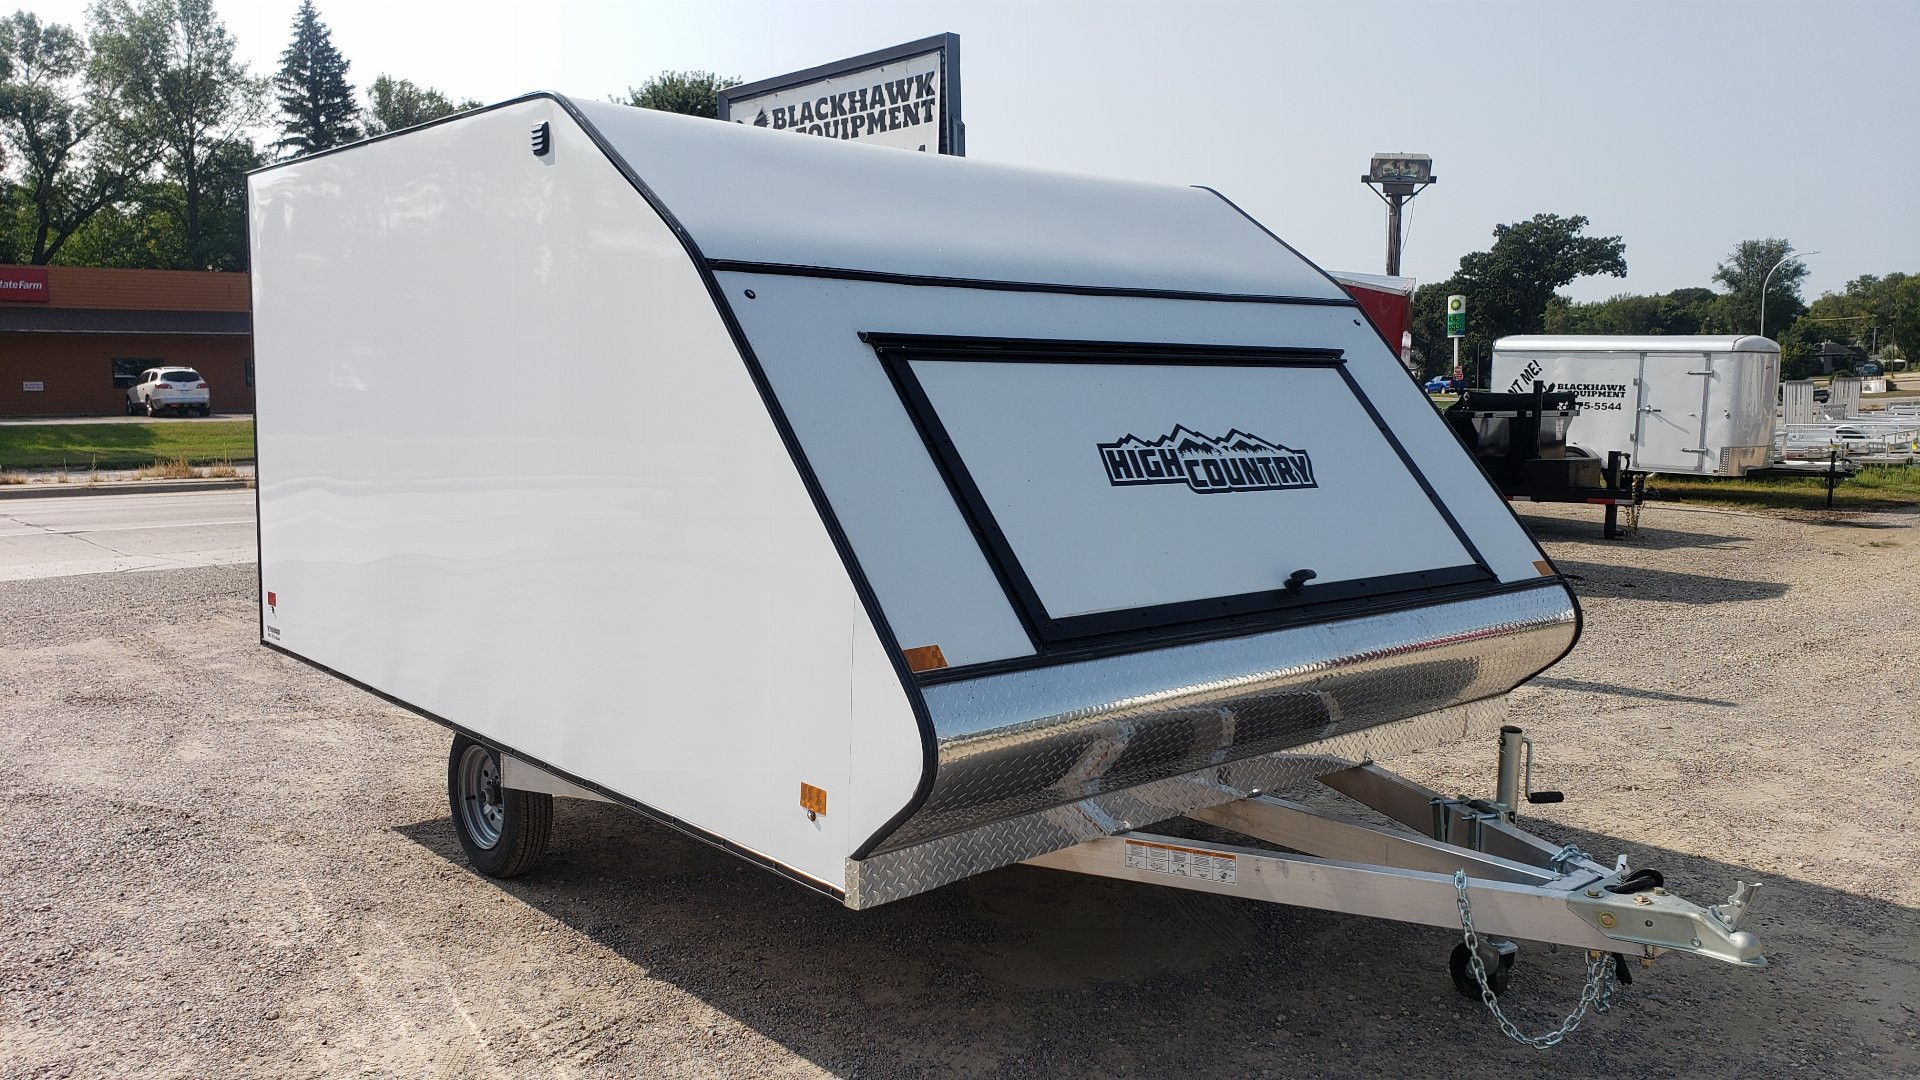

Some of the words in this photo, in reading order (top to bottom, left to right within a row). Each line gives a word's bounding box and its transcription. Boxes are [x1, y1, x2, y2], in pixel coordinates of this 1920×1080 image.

[772, 71, 935, 130] BLACKHAWK
[1520, 359, 1543, 385] ME!
[1557, 383, 1627, 392] BLACKHAWK
[1569, 390, 1627, 398] QUIPMENT
[1105, 448, 1185, 480] HIGH
[1183, 455, 1311, 488] COUNTRY
